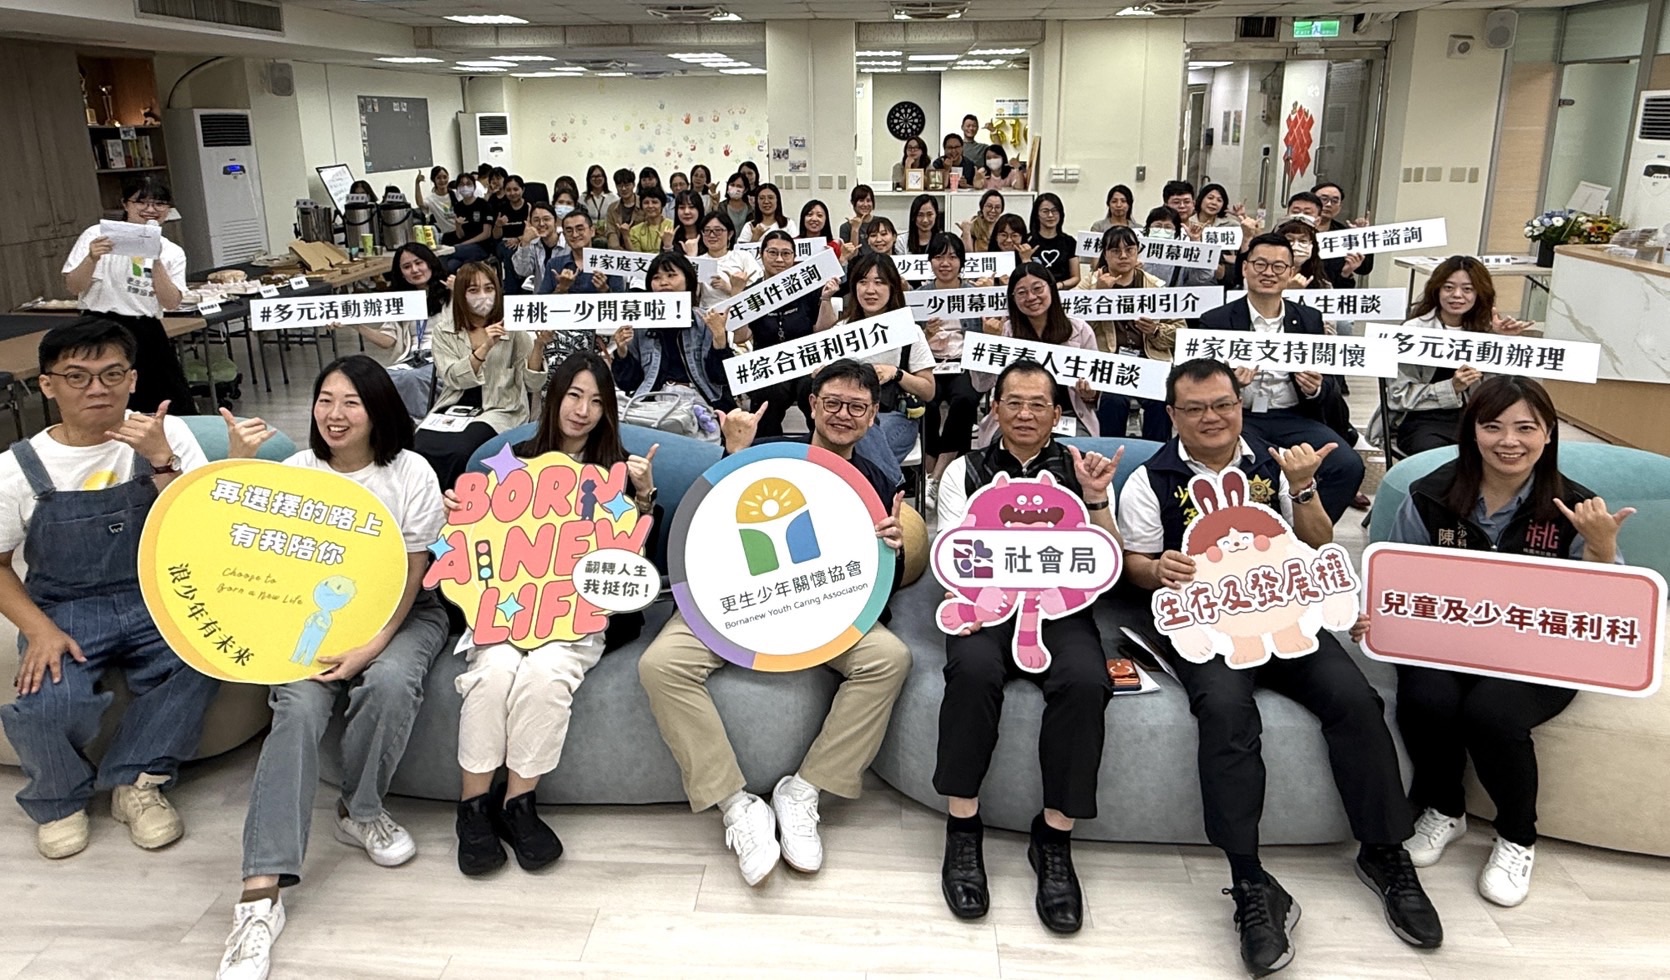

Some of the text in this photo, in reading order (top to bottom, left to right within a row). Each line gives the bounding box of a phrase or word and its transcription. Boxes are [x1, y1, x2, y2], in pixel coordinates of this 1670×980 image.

[1082, 237, 1213, 264] #開幕啦！
[1321, 226, 1423, 252] 年事件諮詢
[897, 257, 997, 276] 少年空間
[729, 263, 823, 321] 年事件諮詢
[905, 292, 1008, 315] 一少開幕啦
[1061, 292, 1200, 315] #綜合福利引介
[260, 297, 405, 323] #多元活動辦理
[512, 299, 682, 324] #桃一少開幕啦！
[736, 322, 889, 385] #綜合福利引介
[1185, 336, 1366, 368] #家庭支持關懷
[210, 477, 384, 537] 再選擇的路上
[448, 461, 628, 526] BORN
[229, 522, 347, 566] 有我陪你
[422, 514, 655, 590] A NEW
[1438, 528, 1455, 546] 陳
[222, 567, 277, 584] Choose to
[584, 560, 648, 578] 翻轉人生
[1004, 545, 1096, 574] 社會局
[583, 578, 650, 599] 我挺你！
[719, 560, 862, 615] 更生少年關懷協會
[1160, 553, 1352, 627] 生存及發展權
[168, 562, 254, 667] 浪少年有未來
[473, 579, 609, 646] LIFE
[724, 582, 869, 630] Bornanew Youth Caring Association
[1380, 590, 1641, 647] 兒童及少年福利科
